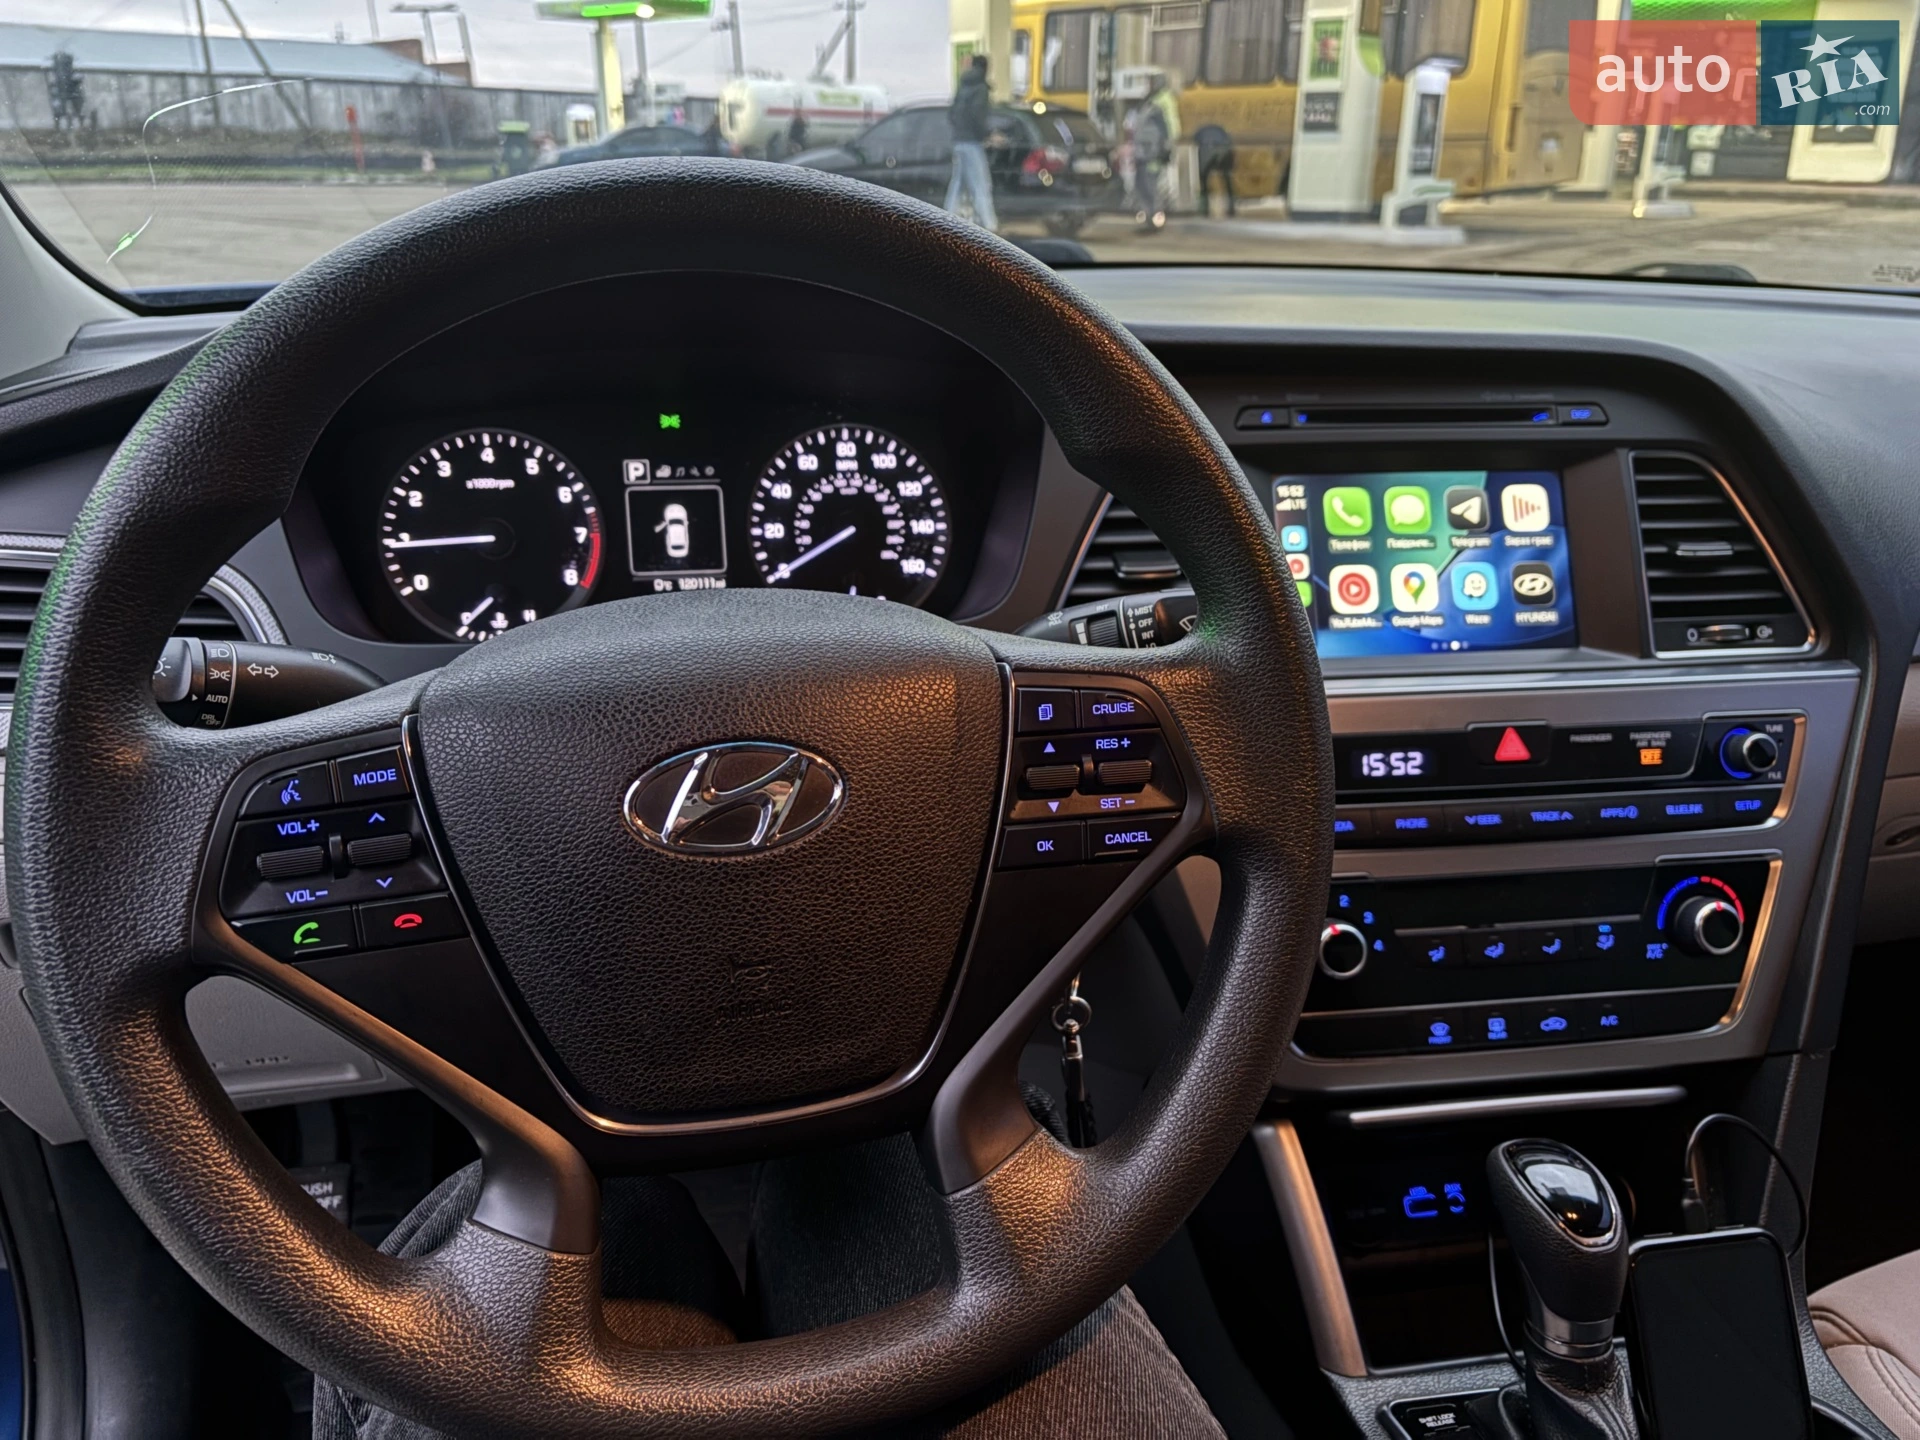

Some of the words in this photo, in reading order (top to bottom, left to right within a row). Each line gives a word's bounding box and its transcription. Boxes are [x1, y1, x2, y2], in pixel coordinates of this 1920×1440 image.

[480, 447, 495, 463] 4
[835, 441, 857, 457] 80
[525, 458, 539, 475] 5
[797, 454, 818, 471] 60
[871, 453, 897, 469] 100
[437, 460, 452, 477] 3
[628, 461, 645, 482] P
[558, 486, 572, 503] 6
[770, 483, 792, 499] 40
[897, 481, 923, 497] 120
[408, 491, 423, 507] 2
[764, 523, 785, 539] 20
[909, 519, 935, 535] 140
[573, 526, 587, 544] 7
[1451, 536, 1491, 549] Telegram
[900, 559, 926, 574] 160
[413, 574, 429, 591] 0
[563, 568, 578, 586] 8
[1134, 604, 1154, 616] MIST
[1138, 618, 1153, 628] OFF
[1465, 614, 1491, 625] Waze
[1515, 611, 1558, 624] HYUNDAI
[1141, 630, 1155, 640] INT
[205, 694, 229, 704] AUTO
[1092, 702, 1135, 715] CRUISE
[1766, 724, 1783, 733] TUNE
[1630, 731, 1671, 741] PASSENGER
[1095, 738, 1119, 750] RES
[353, 768, 397, 786] MODE
[1768, 771, 1782, 780] FILE
[1100, 797, 1122, 809] SET
[1735, 800, 1761, 811] SETUP
[1395, 817, 1428, 830] PHONE
[1478, 814, 1502, 826] SEEK
[1531, 811, 1561, 822] TRACK
[1334, 820, 1355, 833] EDIA
[1105, 831, 1152, 845] CANCEL
[1036, 840, 1054, 852] OK
[1339, 894, 1350, 908] 2
[1363, 911, 1374, 925] 3
[300, 1181, 333, 1196] USH
[1425, 1418, 1456, 1428] RELEASE
[1438, 1412, 1456, 1421] LOCK
